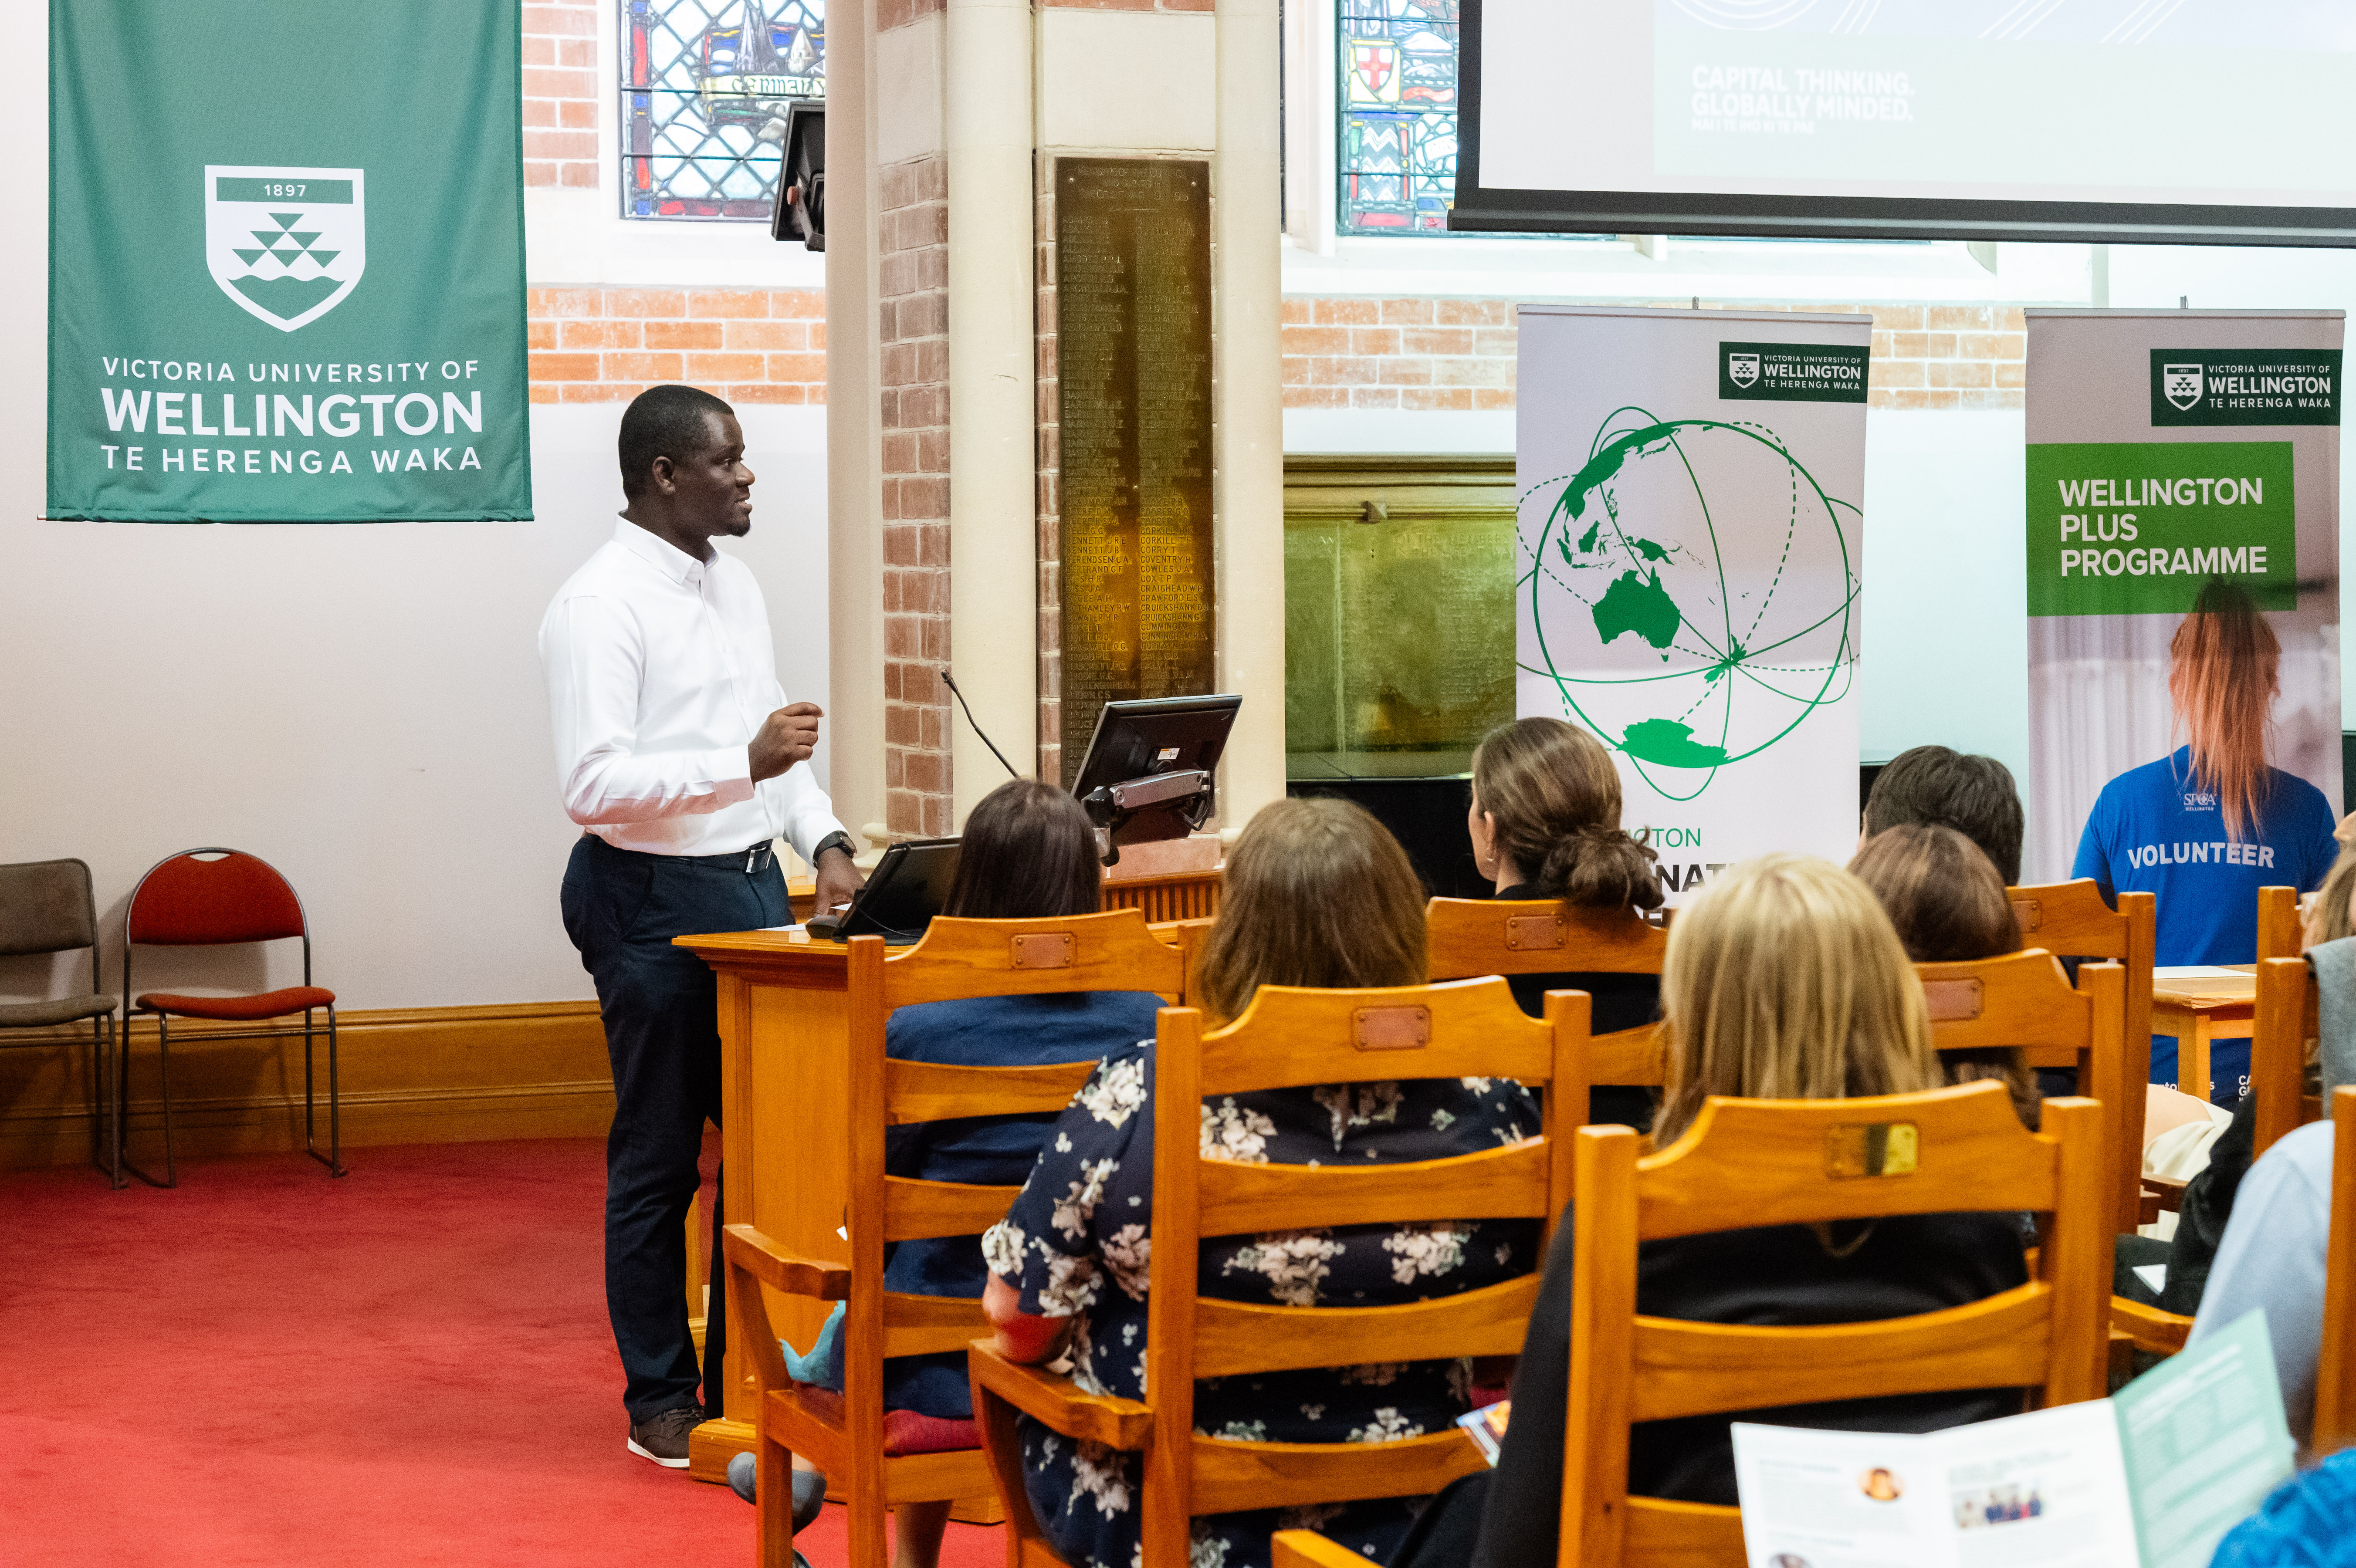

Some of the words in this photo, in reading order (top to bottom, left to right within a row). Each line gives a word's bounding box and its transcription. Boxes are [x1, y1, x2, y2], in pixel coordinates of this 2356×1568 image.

[1693, 67, 1787, 91] CAPITAL
[1797, 71, 1914, 95] THINKING.
[1693, 93, 1810, 118] GLOBALLY
[1817, 97, 1913, 120] MINDED.
[264, 184, 306, 197] 1897
[102, 357, 234, 382] VICTORIA
[249, 361, 430, 382] UNIVERSITY
[441, 360, 478, 379] OF
[1764, 364, 1861, 379] WELLINGTON
[2259, 365, 2315, 373] UNIVERSITY
[1781, 380, 1829, 389] HERENGA
[1834, 382, 1860, 390] WAKA
[2209, 377, 2331, 394] WELLINGTON
[101, 388, 482, 437] WELLINGTON
[2210, 398, 2223, 408] TE
[2230, 397, 2293, 408] HERENGA
[2298, 398, 2331, 408] WAKA
[101, 445, 144, 470] TE
[162, 448, 353, 474] HERENGA
[371, 446, 481, 473] WAKA
[2058, 477, 2263, 507] WELLINGTON
[2060, 514, 2138, 542] PLUS
[2061, 547, 2267, 577] PROGRAMME
[2127, 842, 2274, 869] VOLUNTEER
